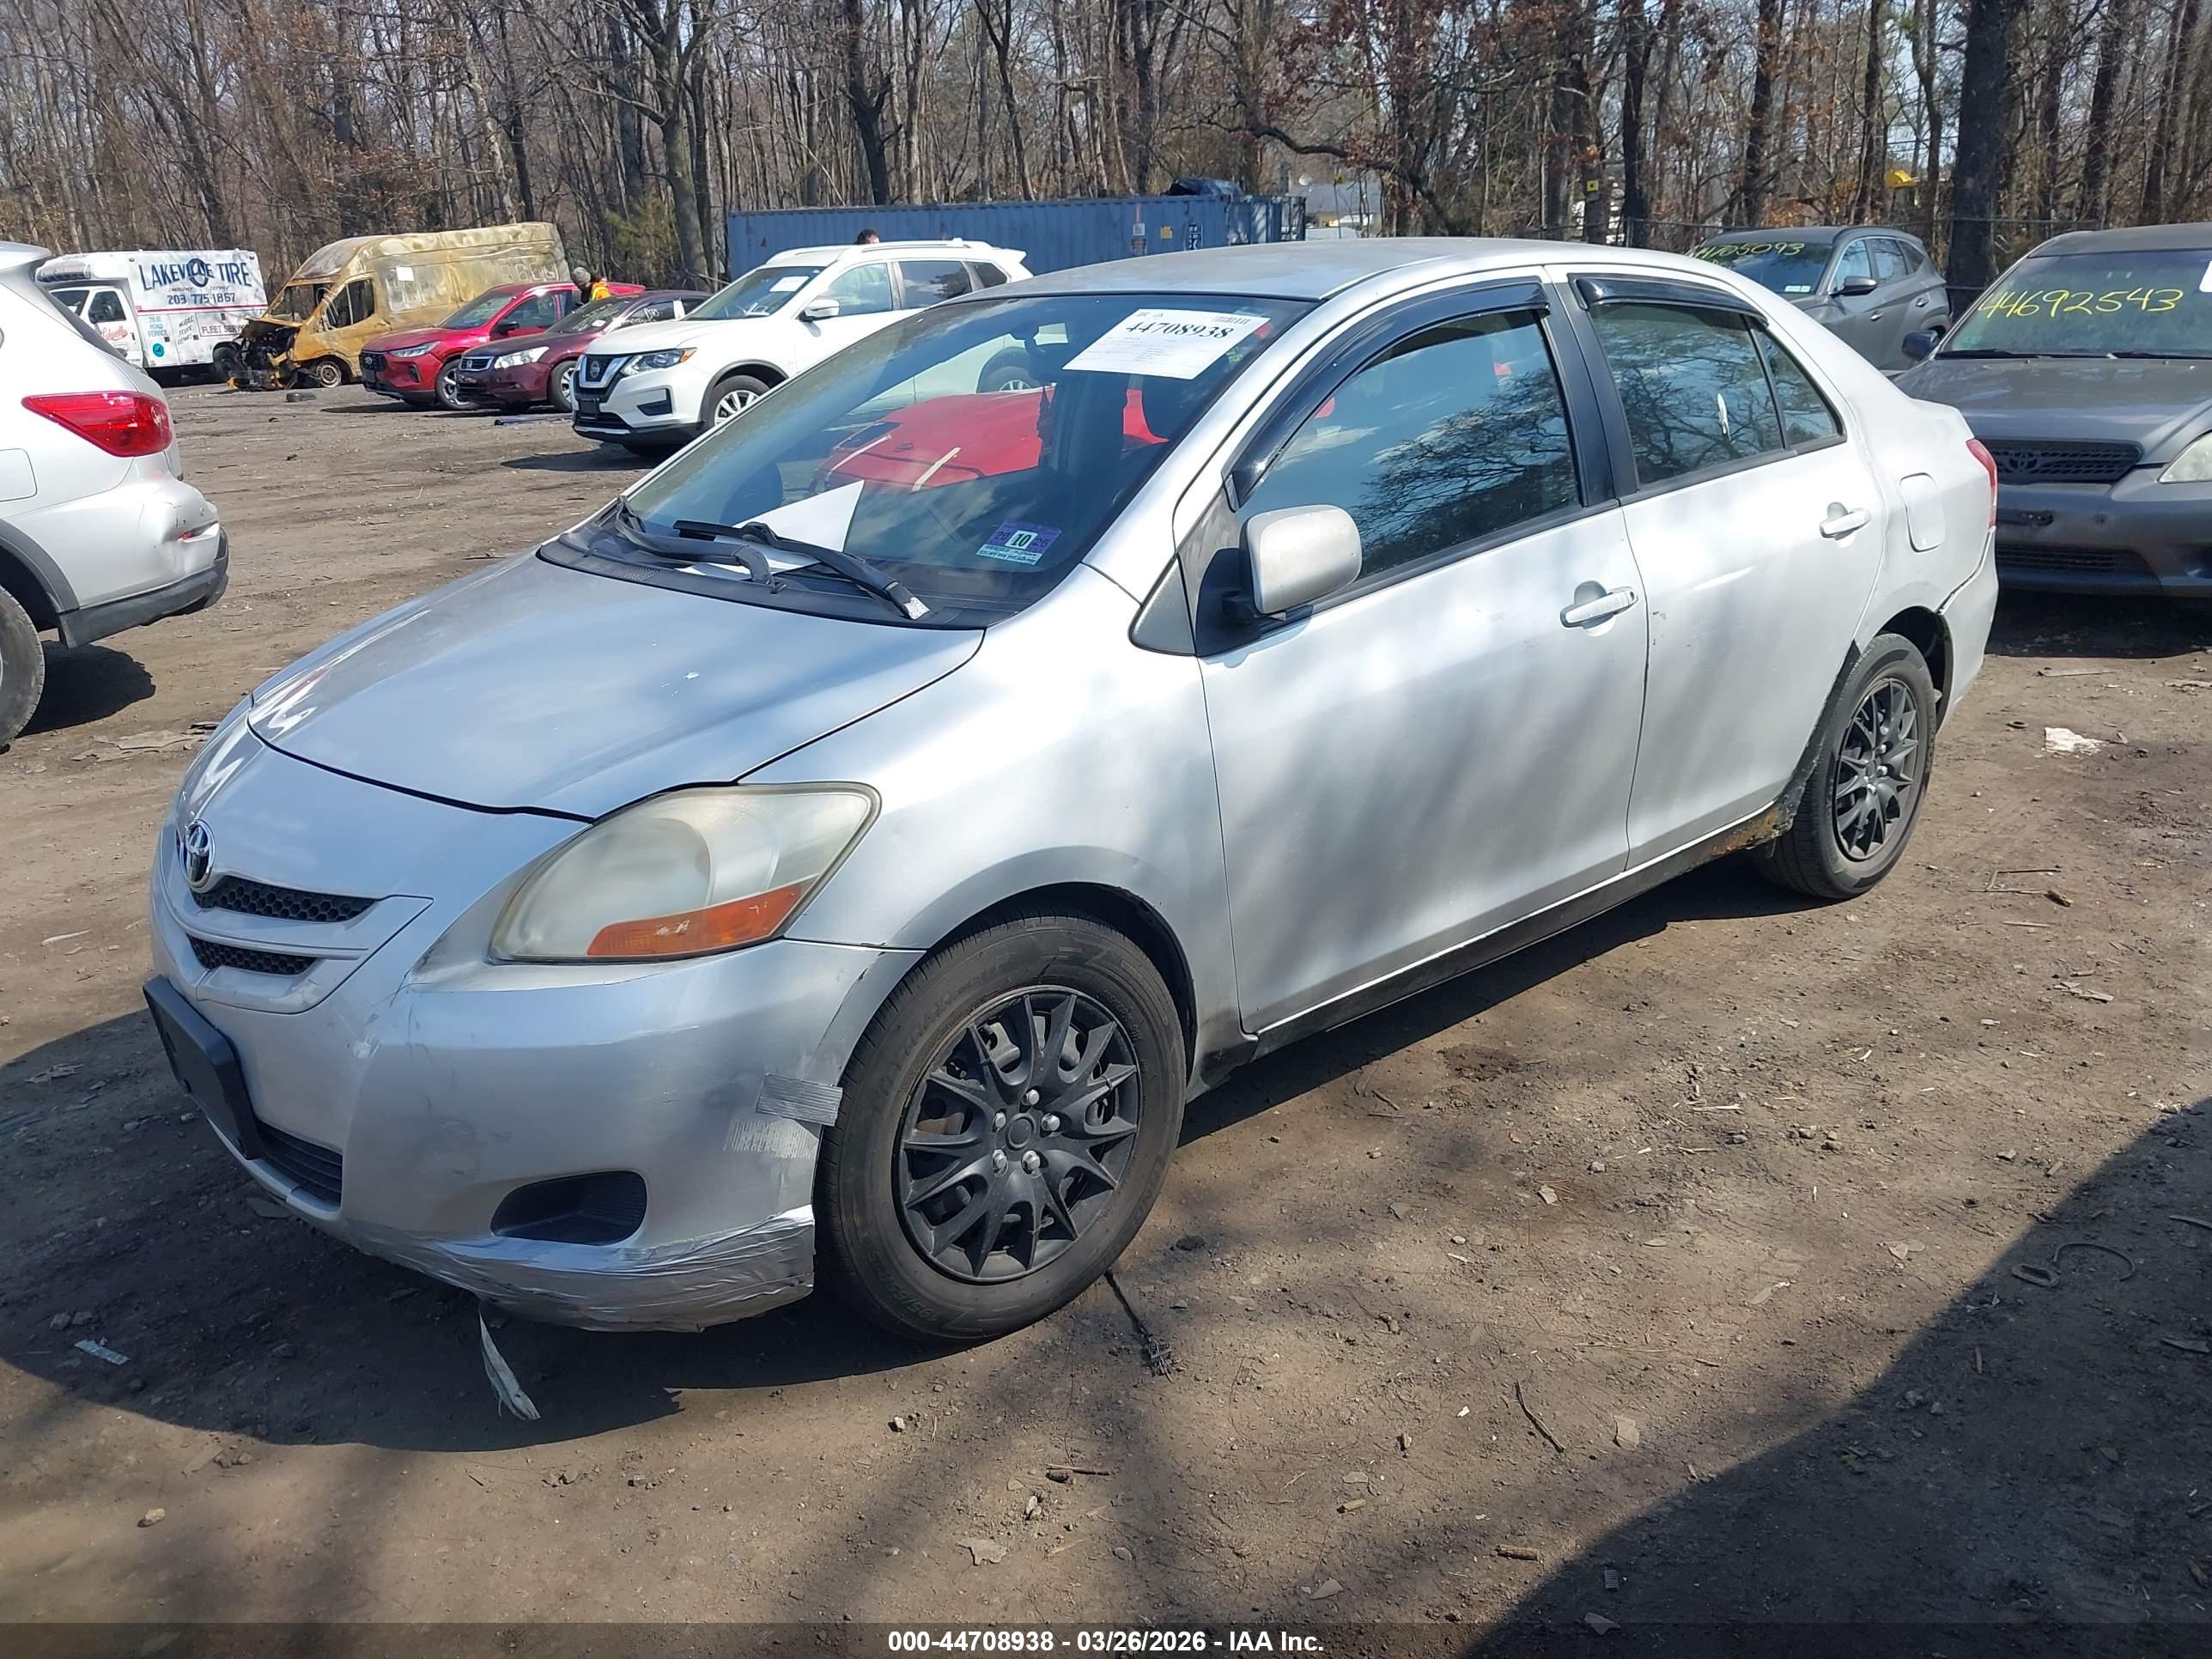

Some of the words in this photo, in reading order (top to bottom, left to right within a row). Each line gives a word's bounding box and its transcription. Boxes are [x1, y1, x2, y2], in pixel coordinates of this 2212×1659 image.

[216, 262, 252, 288] TIRE
[167, 294, 187, 305] 203
[1977, 287, 2185, 319] 44692543
[202, 325, 222, 335] FLEET
[1126, 321, 1235, 339] 44708938
[1010, 532, 1032, 547] 10
